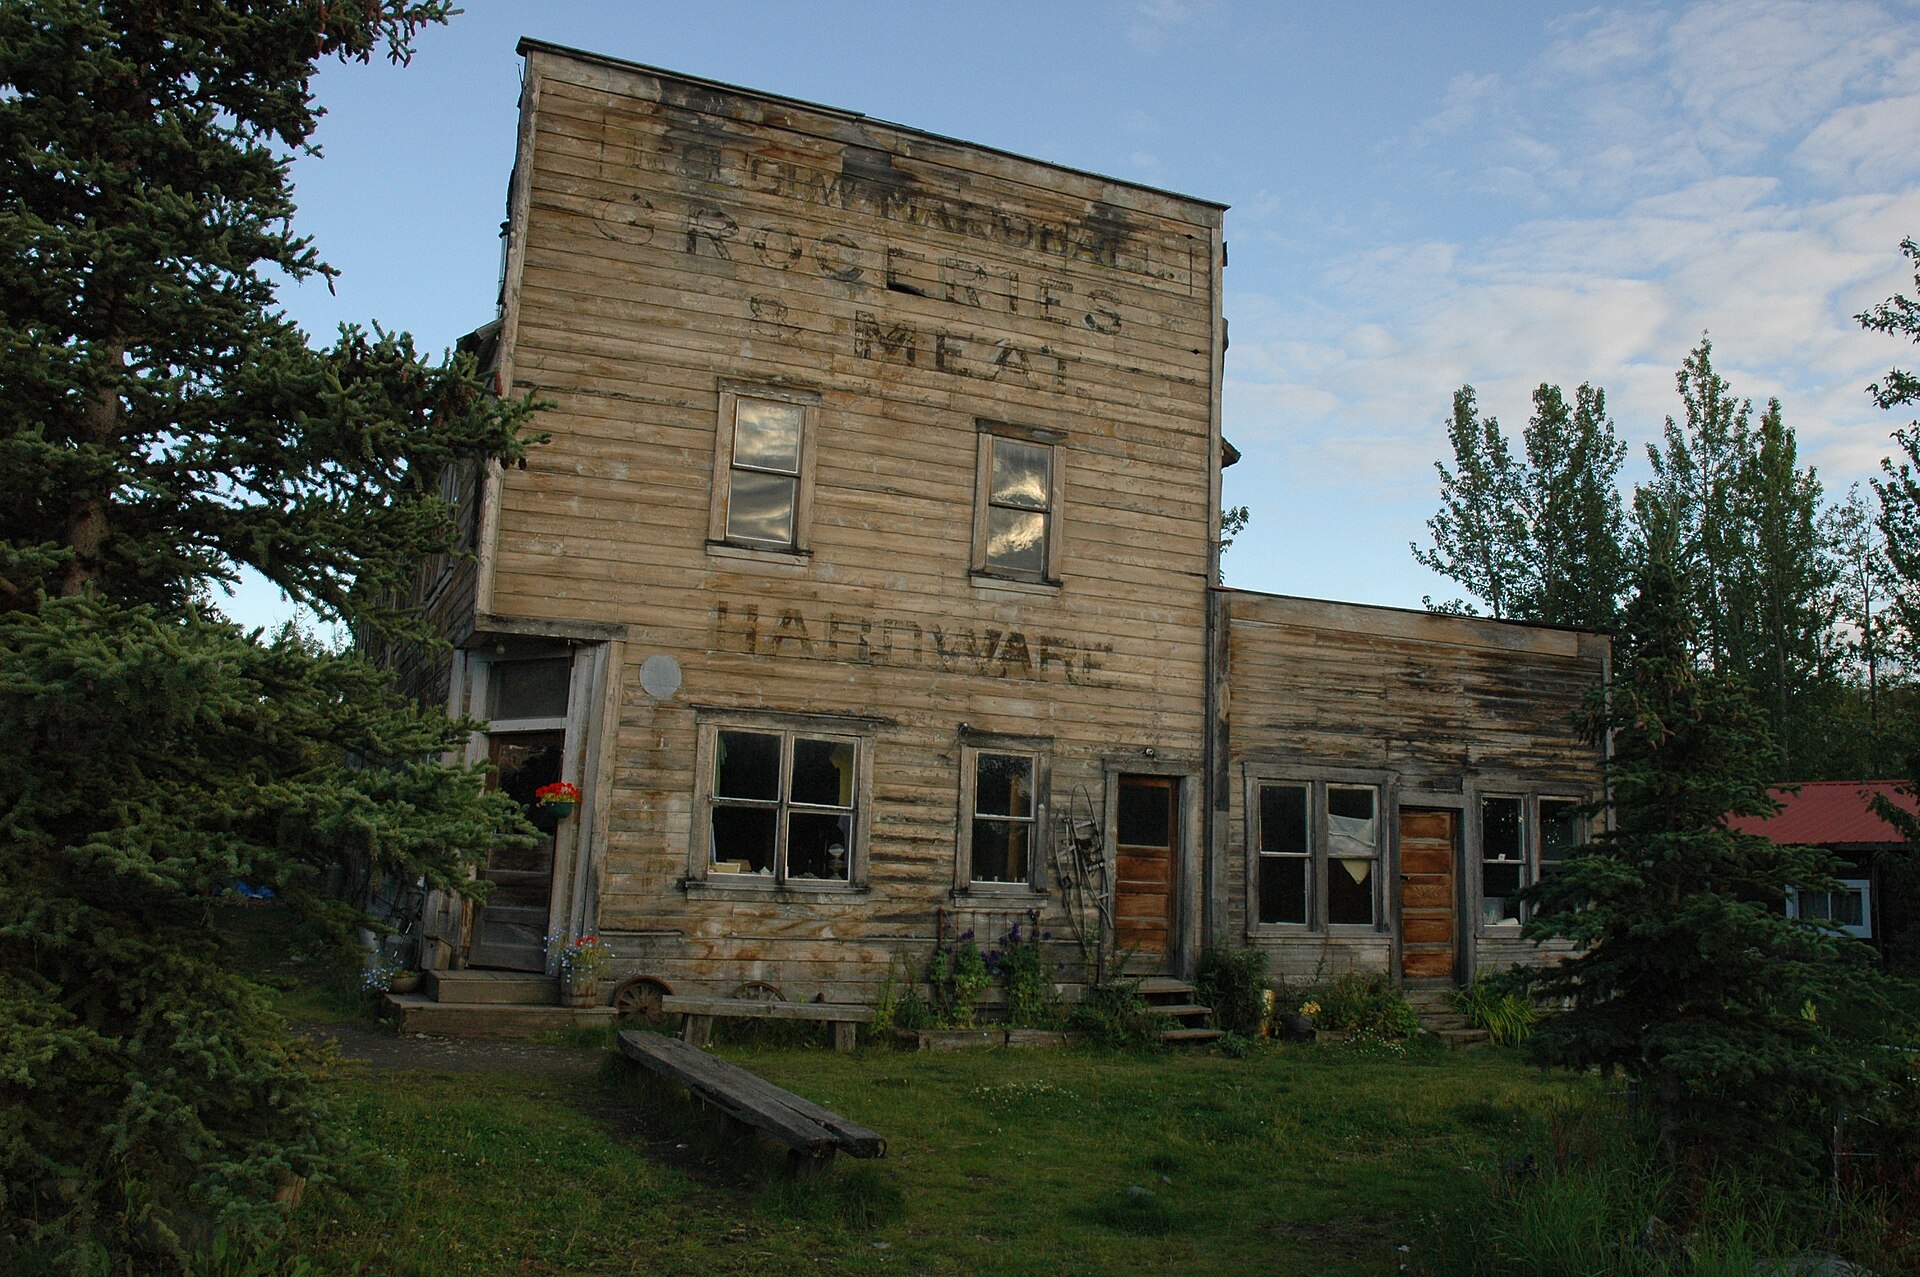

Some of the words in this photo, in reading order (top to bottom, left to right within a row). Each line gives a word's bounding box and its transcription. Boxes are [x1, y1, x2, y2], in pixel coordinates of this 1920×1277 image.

[593, 190, 1123, 336] GROCERIES
[749, 292, 800, 338] &
[713, 600, 1114, 687] HARDWARE
